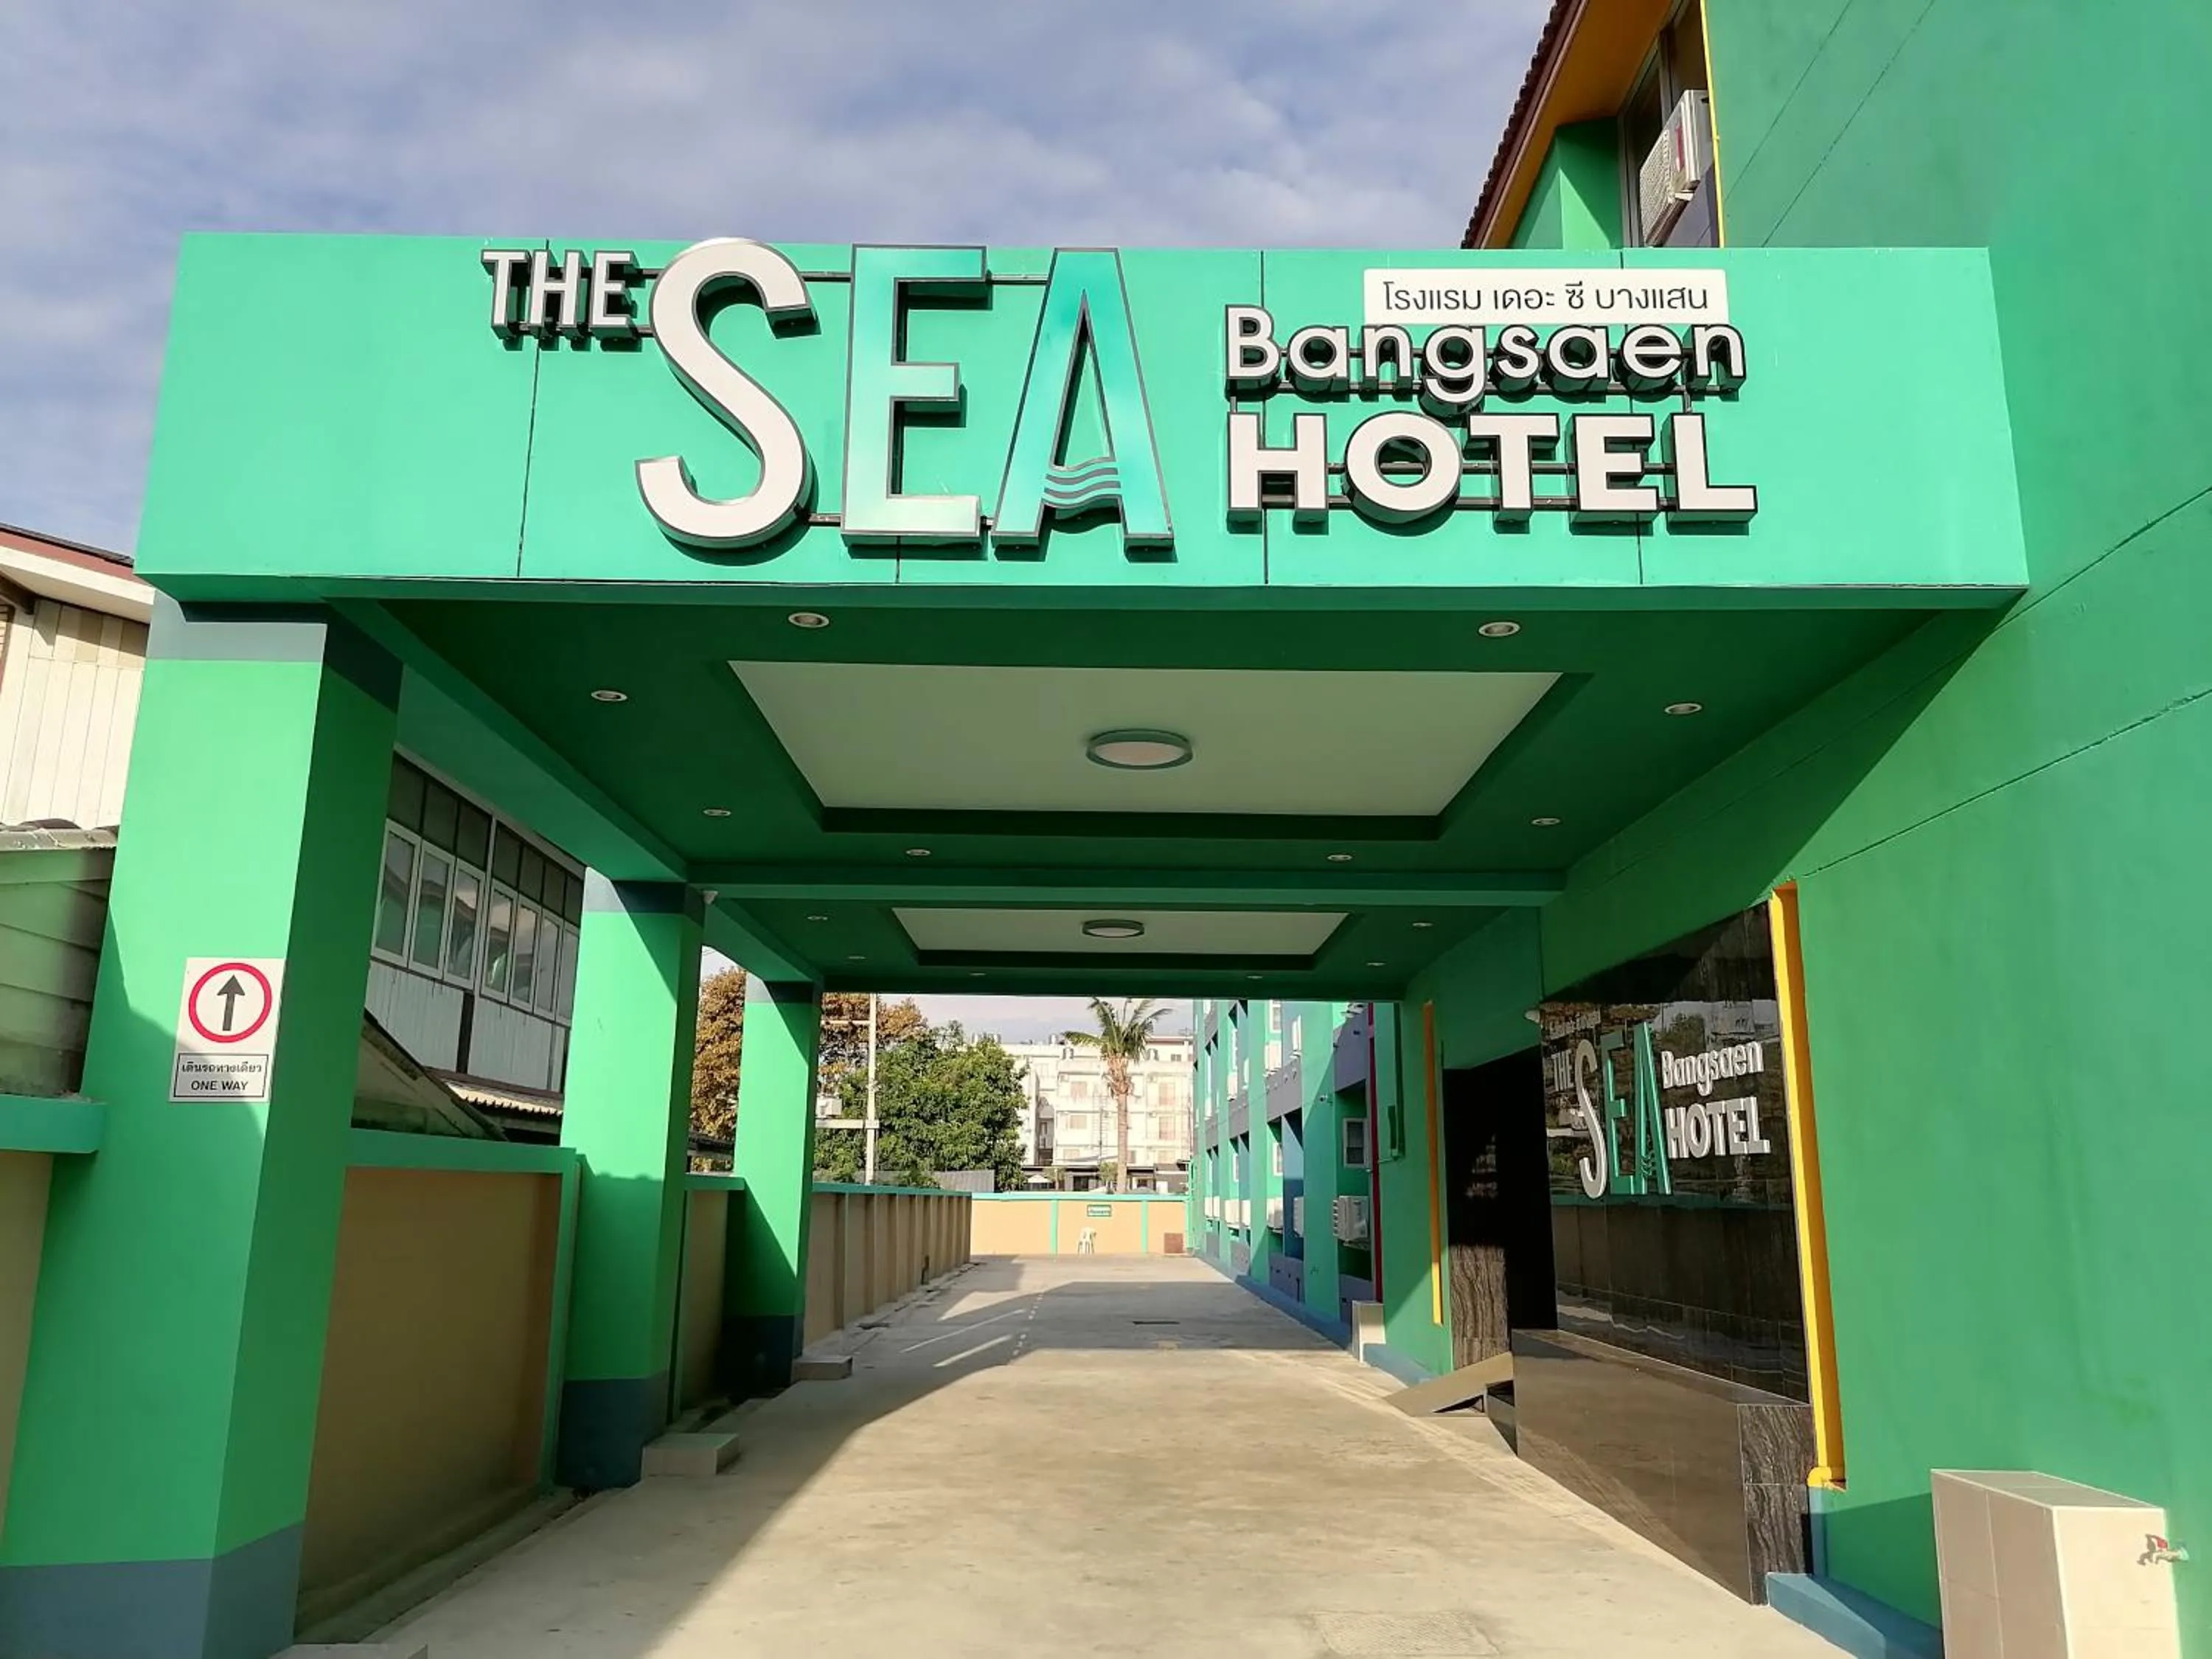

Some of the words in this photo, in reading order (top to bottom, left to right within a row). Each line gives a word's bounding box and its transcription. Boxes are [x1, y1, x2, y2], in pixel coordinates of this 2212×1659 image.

[1382, 281, 1481, 311] โรงแรม
[1493, 288, 1555, 310] เดอะ
[1565, 280, 1585, 310] ซี
[1595, 287, 1708, 310] บางแสน
[1225, 304, 1747, 406] Bangsaen
[481, 249, 636, 332] THE
[635, 237, 1174, 547] SEA
[1227, 410, 1758, 519] HOTEL
[182, 1061, 262, 1073] เดินรถทางเดียว
[191, 1080, 218, 1091] ONE
[221, 1080, 248, 1091] WAY
[1660, 1040, 1765, 1096] Bangsaen
[1551, 1048, 1574, 1092] THE
[1574, 1022, 1672, 1200] SEA
[1664, 1096, 1771, 1160] HOTEL
